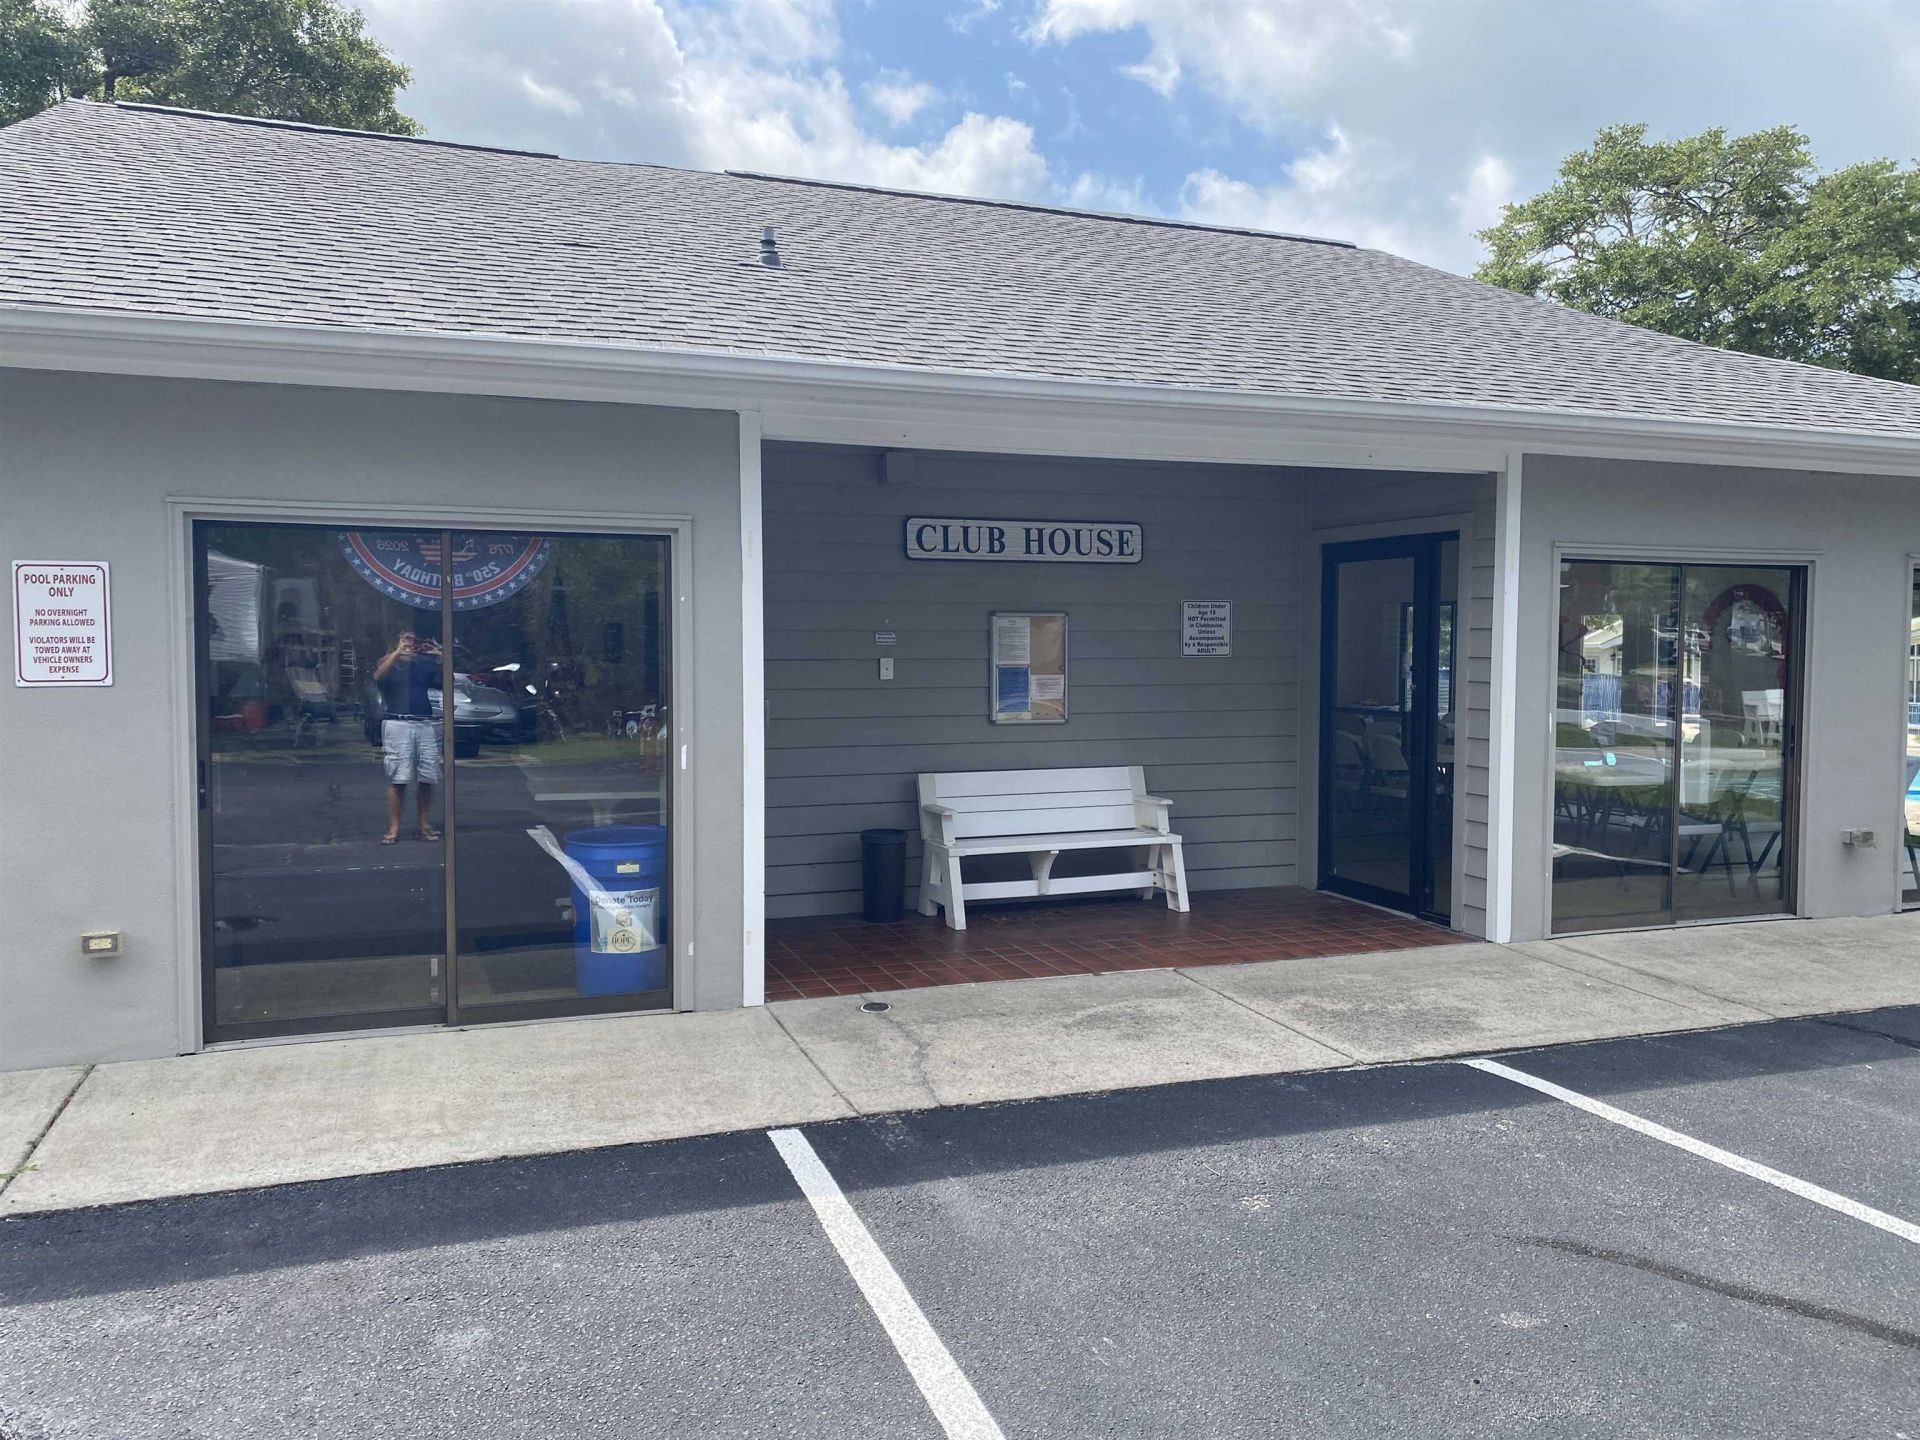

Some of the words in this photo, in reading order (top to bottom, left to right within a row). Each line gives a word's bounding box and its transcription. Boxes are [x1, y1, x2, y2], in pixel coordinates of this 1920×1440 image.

[915, 524, 1006, 554] CLUB
[1023, 527, 1135, 557] HOUSE
[24, 574, 51, 584] POOL
[53, 574, 96, 585] PARKING
[48, 587, 74, 597] ONLY
[35, 608, 46, 617] NO
[47, 608, 88, 617] OVERNIGHT
[29, 618, 61, 627] PARKING
[62, 618, 96, 627] ALLOWED
[29, 636, 68, 644] VIOLATORS
[69, 636, 86, 644] WILL
[87, 636, 96, 644] BE
[35, 646, 60, 654] TOWED
[61, 646, 81, 654] AWAY
[82, 646, 91, 654] AT
[33, 656, 62, 664] VEHICLE
[63, 656, 93, 664] OWNERS
[49, 665, 80, 673] EXPENSE
[628, 895, 654, 904] Today
